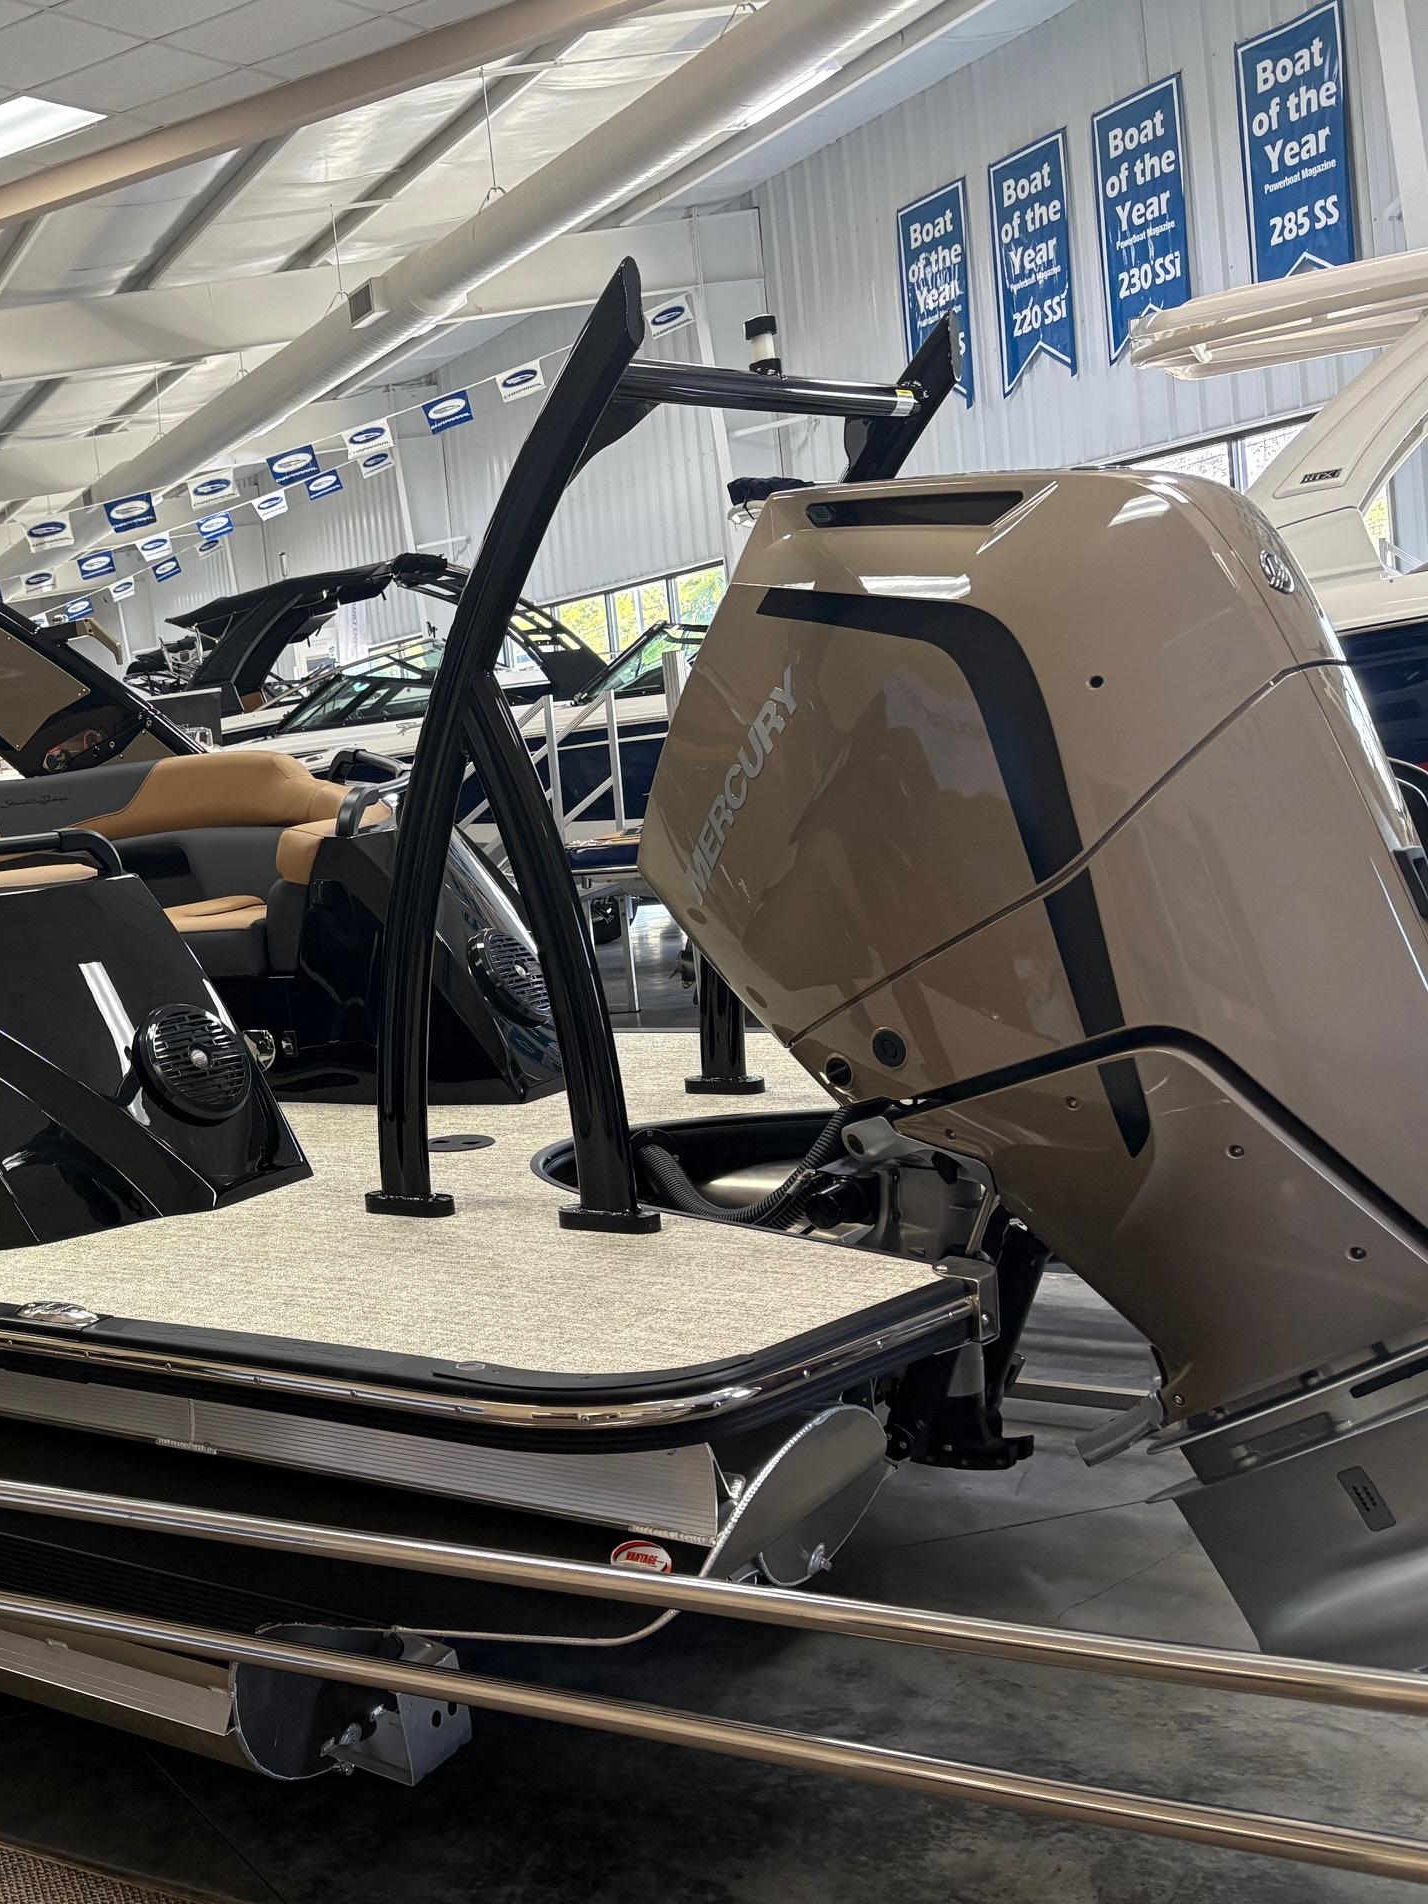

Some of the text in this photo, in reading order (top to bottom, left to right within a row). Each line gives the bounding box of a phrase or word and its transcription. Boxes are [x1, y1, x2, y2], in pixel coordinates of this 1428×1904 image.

[1256, 36, 1323, 94] Boat
[1252, 81, 1338, 137] of the
[1108, 108, 1164, 160] Boat
[1264, 126, 1332, 174] Year
[1002, 162, 1051, 208] Boat
[1105, 149, 1176, 199] of the
[1264, 158, 1337, 195] Powerboat Magazine
[909, 208, 954, 250] Boat
[1000, 199, 1061, 245] of the
[1115, 190, 1171, 232] Year
[1269, 194, 1340, 247] 285 SS
[908, 243, 963, 284] of the
[1008, 237, 1057, 276] Year
[1118, 250, 1181, 300] 230 SSi
[915, 279, 961, 314] Year
[1012, 294, 1067, 338] 220 SSi
[686, 662, 798, 906] MERCURY
[625, 1550, 659, 1566] VANTAGE
